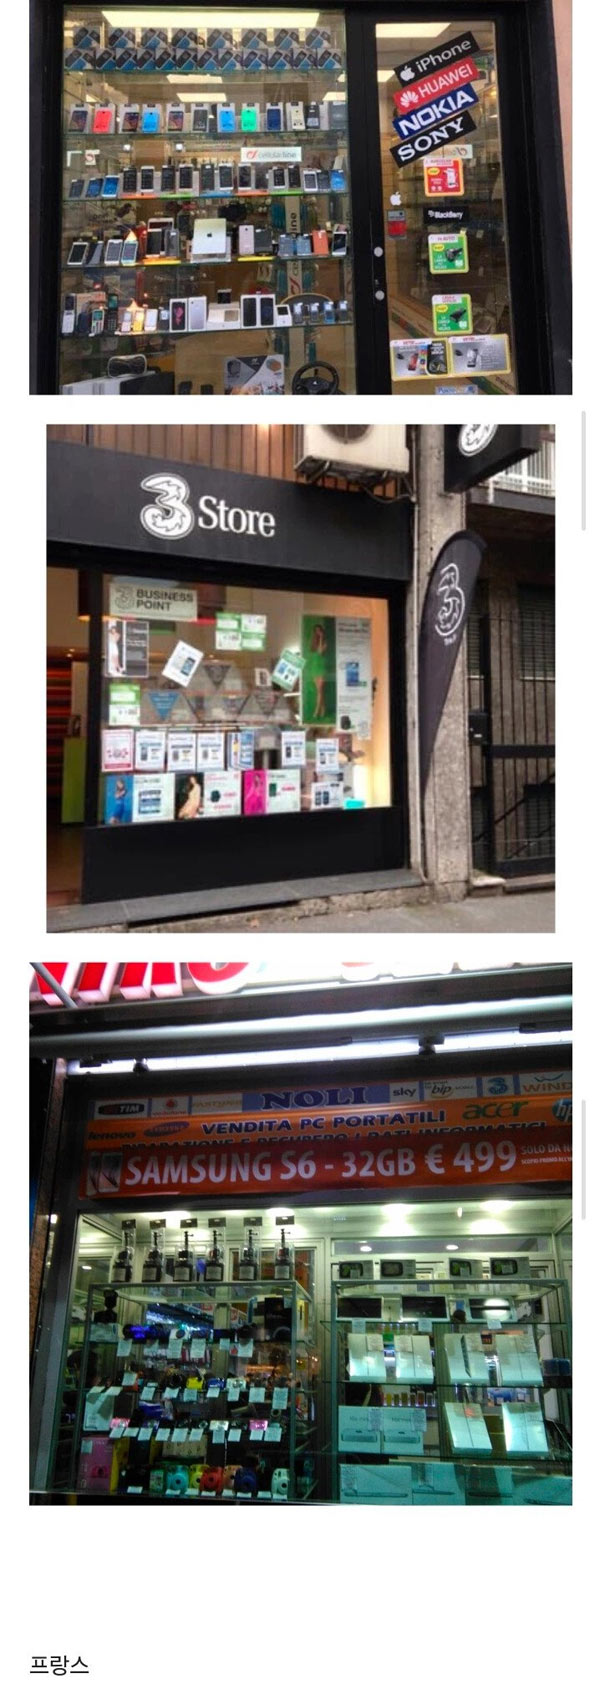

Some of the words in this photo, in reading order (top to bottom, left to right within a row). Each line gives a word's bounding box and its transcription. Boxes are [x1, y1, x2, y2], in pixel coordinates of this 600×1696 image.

[417, 40, 471, 73] iPhone
[419, 64, 473, 98] HUAWEI
[398, 90, 474, 135] NOKIA
[398, 117, 464, 161] SONY
[199, 496, 275, 537] Store
[136, 589, 193, 602] BUSINESS
[261, 1085, 367, 1110] NOLI
[201, 1119, 291, 1135] VENDITA
[300, 1118, 324, 1129] PC
[333, 1111, 445, 1127] PORTATILI
[125, 1151, 271, 1186] SAMSUNG
[280, 1151, 316, 1180] S6
[342, 1147, 415, 1178] 32GB
[454, 1141, 516, 1173] 499
